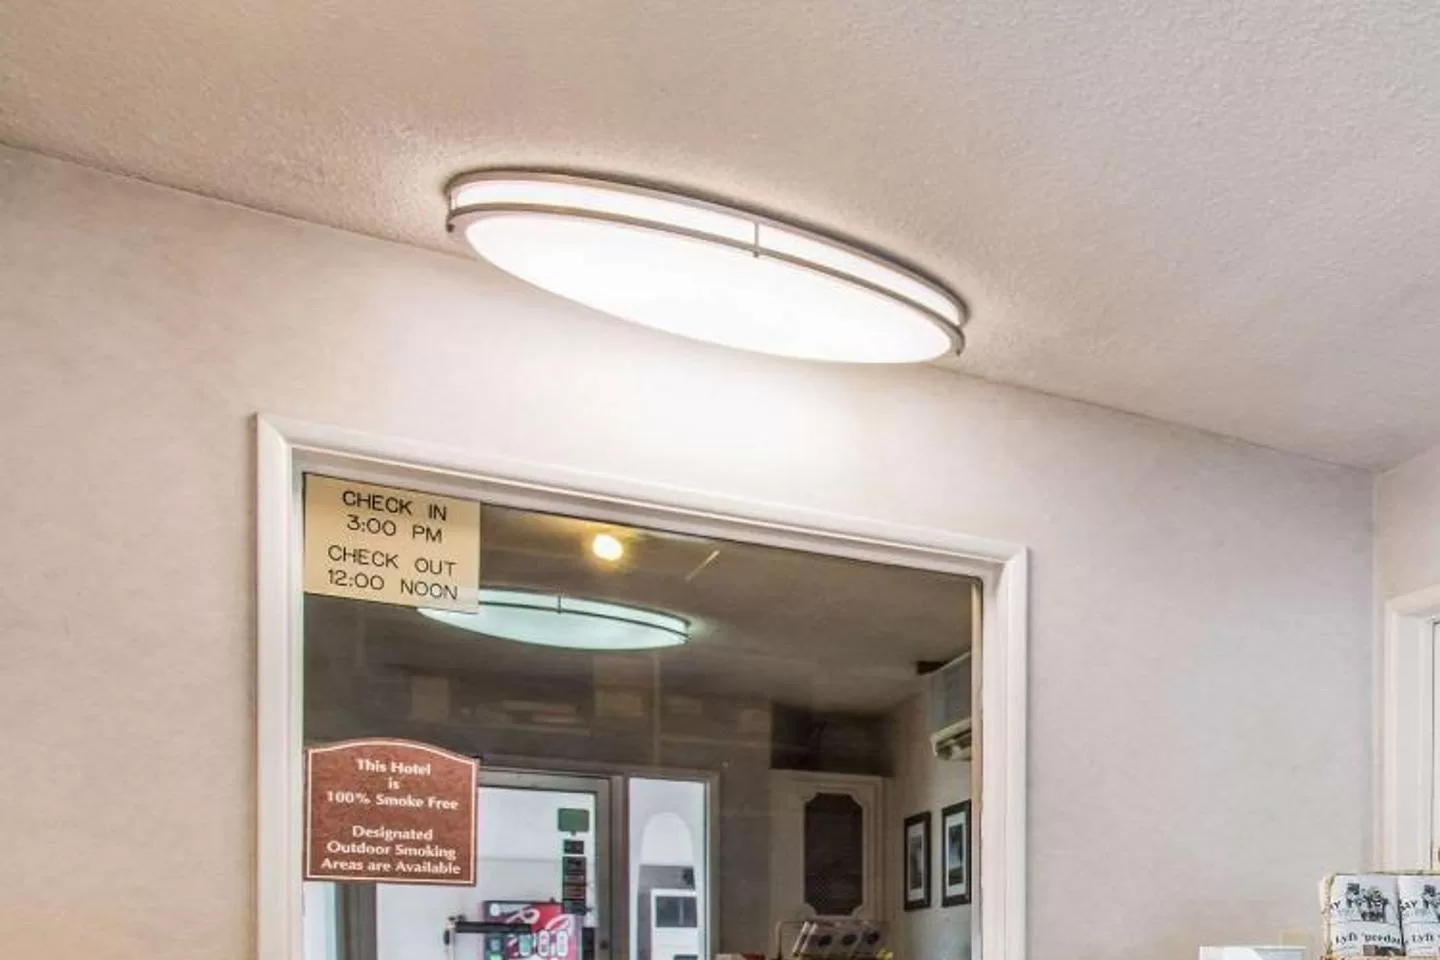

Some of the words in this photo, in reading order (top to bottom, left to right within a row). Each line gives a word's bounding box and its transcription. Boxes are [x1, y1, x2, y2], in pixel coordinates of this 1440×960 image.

[342, 491, 412, 515] CHECK
[428, 503, 447, 522] IN
[347, 514, 397, 537] 3:00
[412, 525, 443, 543] PM
[328, 545, 399, 569] CHECK
[414, 557, 457, 577] OUT
[328, 569, 385, 591] 12:00
[400, 580, 458, 600] NOON
[357, 759, 386, 774] This
[391, 761, 431, 775] Hotel
[388, 777, 400, 789] is
[326, 790, 370, 806] 100%
[376, 794, 423, 809] Smoke
[428, 797, 458, 810] Free
[352, 826, 433, 841] Designated
[327, 841, 391, 855] Outdoor
[395, 844, 456, 860] Smoking
[321, 858, 364, 872] Areas
[368, 861, 391, 873] are
[395, 860, 461, 875] Available
